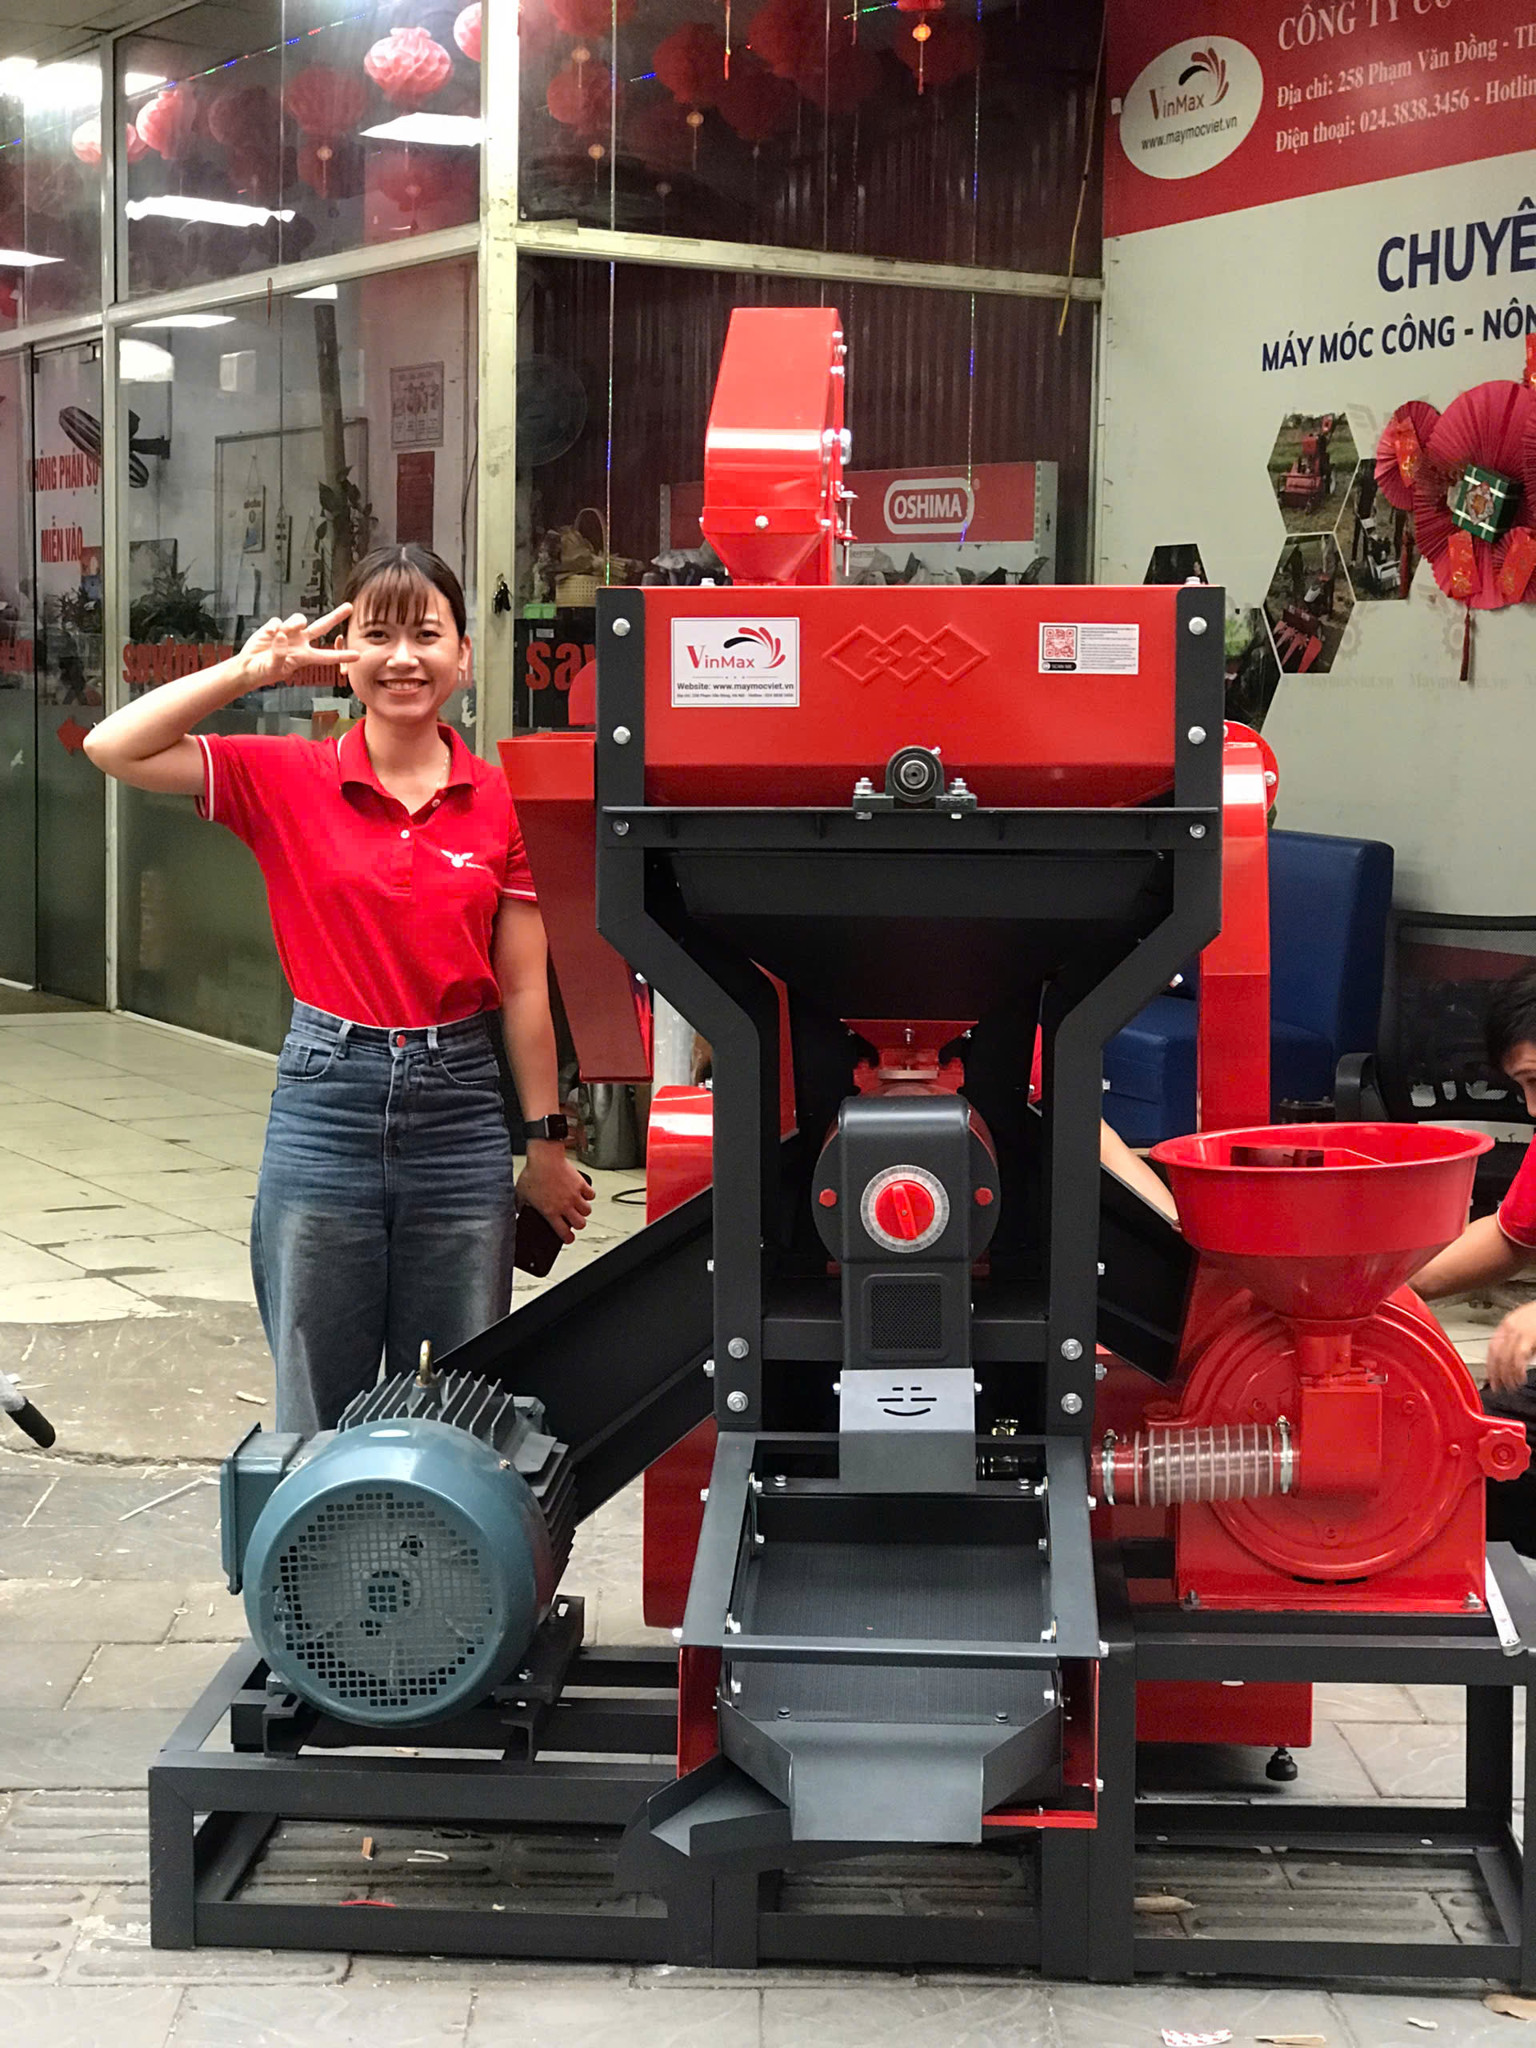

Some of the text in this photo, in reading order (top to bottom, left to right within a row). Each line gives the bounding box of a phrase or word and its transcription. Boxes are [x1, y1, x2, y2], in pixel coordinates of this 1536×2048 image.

[1278, 0, 1357, 50] CÔNG
[1277, 83, 1303, 111] Địa
[1338, 66, 1364, 93] 258
[1368, 60, 1412, 86] Phạm
[1417, 47, 1450, 72] Văn
[1454, 32, 1498, 63] Đồng
[1149, 85, 1205, 120] VinMax
[1276, 126, 1309, 155] Điện
[1313, 114, 1355, 145] thoại:
[1359, 86, 1470, 133] 024.3838.3456
[1141, 115, 1238, 150] www.maymocviet.vn
[1378, 196, 1536, 293] CHUYÊ
[1262, 330, 1315, 372] MÁY
[1319, 321, 1375, 364] MÓC
[1381, 312, 1456, 355] CÔNG
[894, 493, 962, 519] OSHIMA
[685, 644, 756, 669] VinMax
[713, 682, 794, 692] www.maymocviet.vn
